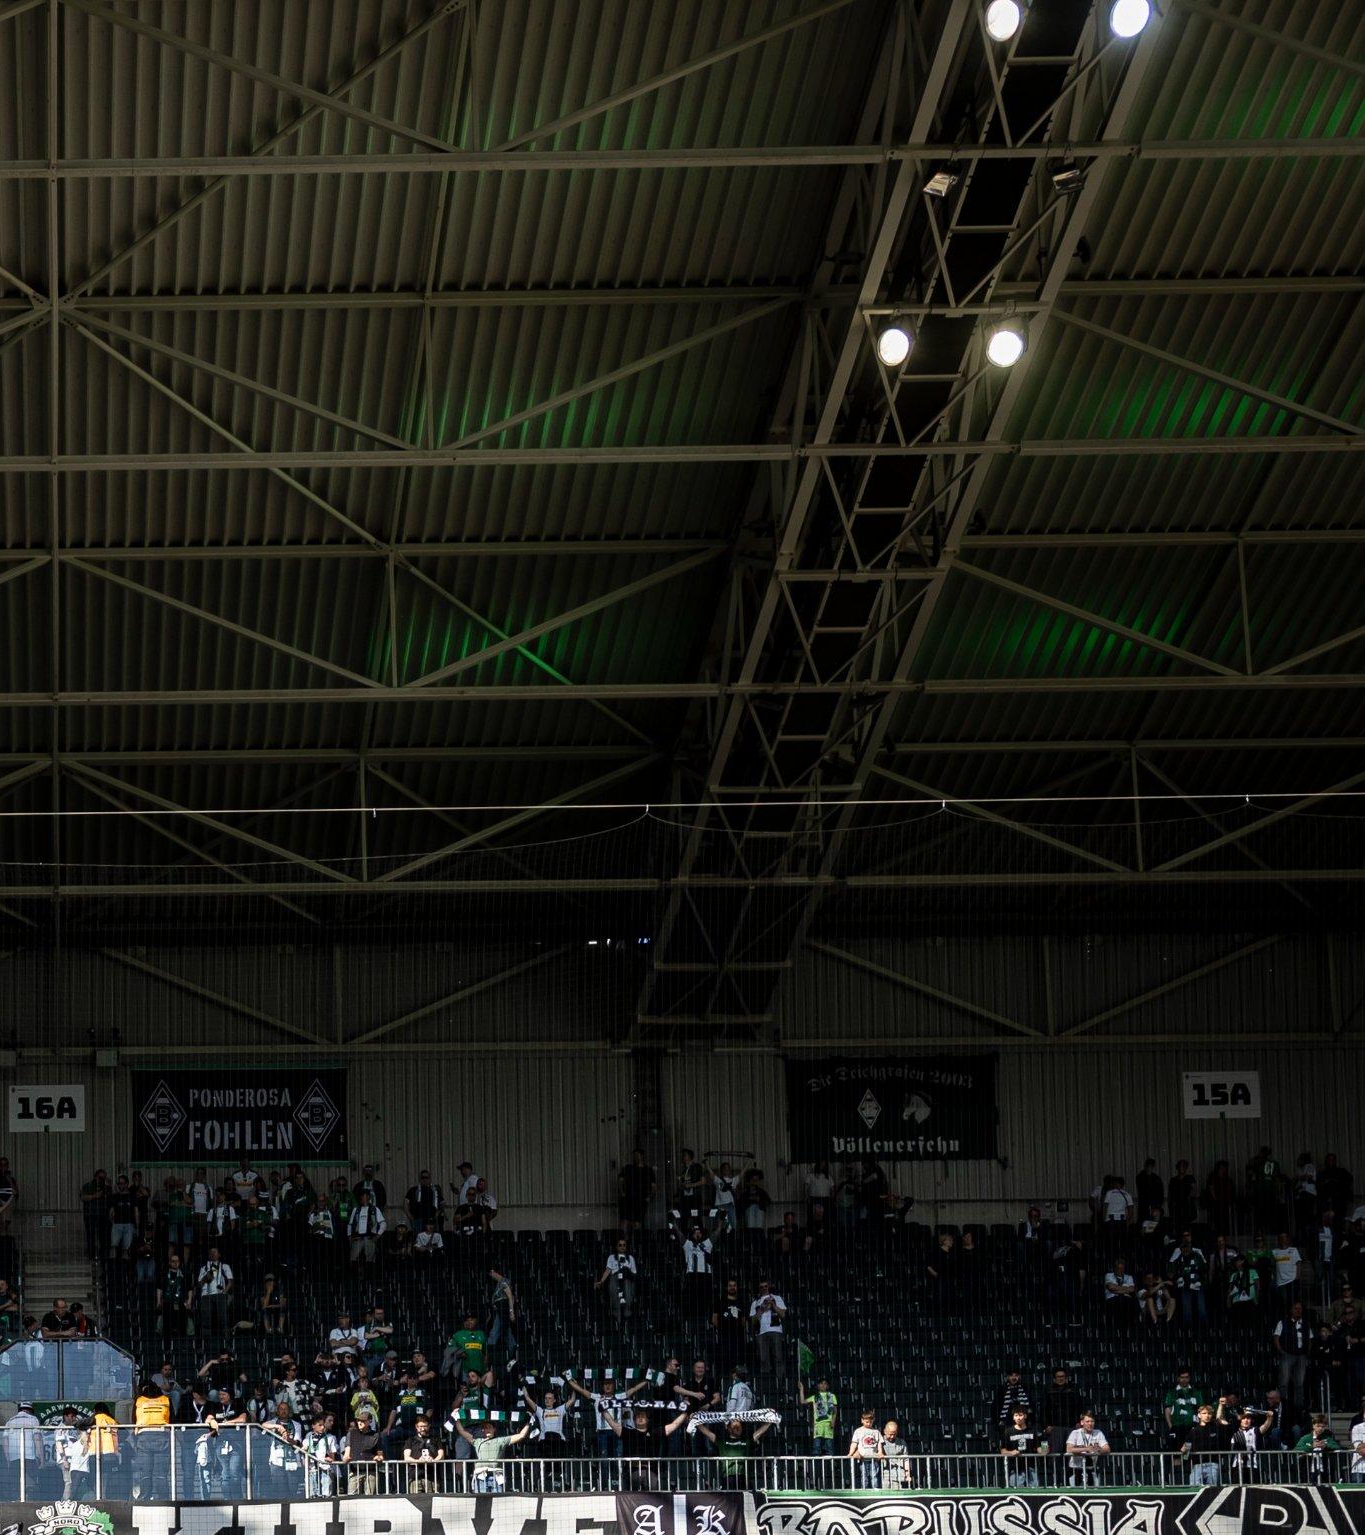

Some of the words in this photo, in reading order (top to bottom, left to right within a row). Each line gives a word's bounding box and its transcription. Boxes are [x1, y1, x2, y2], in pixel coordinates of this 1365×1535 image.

[188, 1088, 292, 1108] PONDEROSA
[1192, 1083, 1251, 1106] 15A
[17, 1096, 77, 1119] 16A
[188, 1119, 293, 1151] FOHLEN
[53, 1518, 80, 1526] NORD
